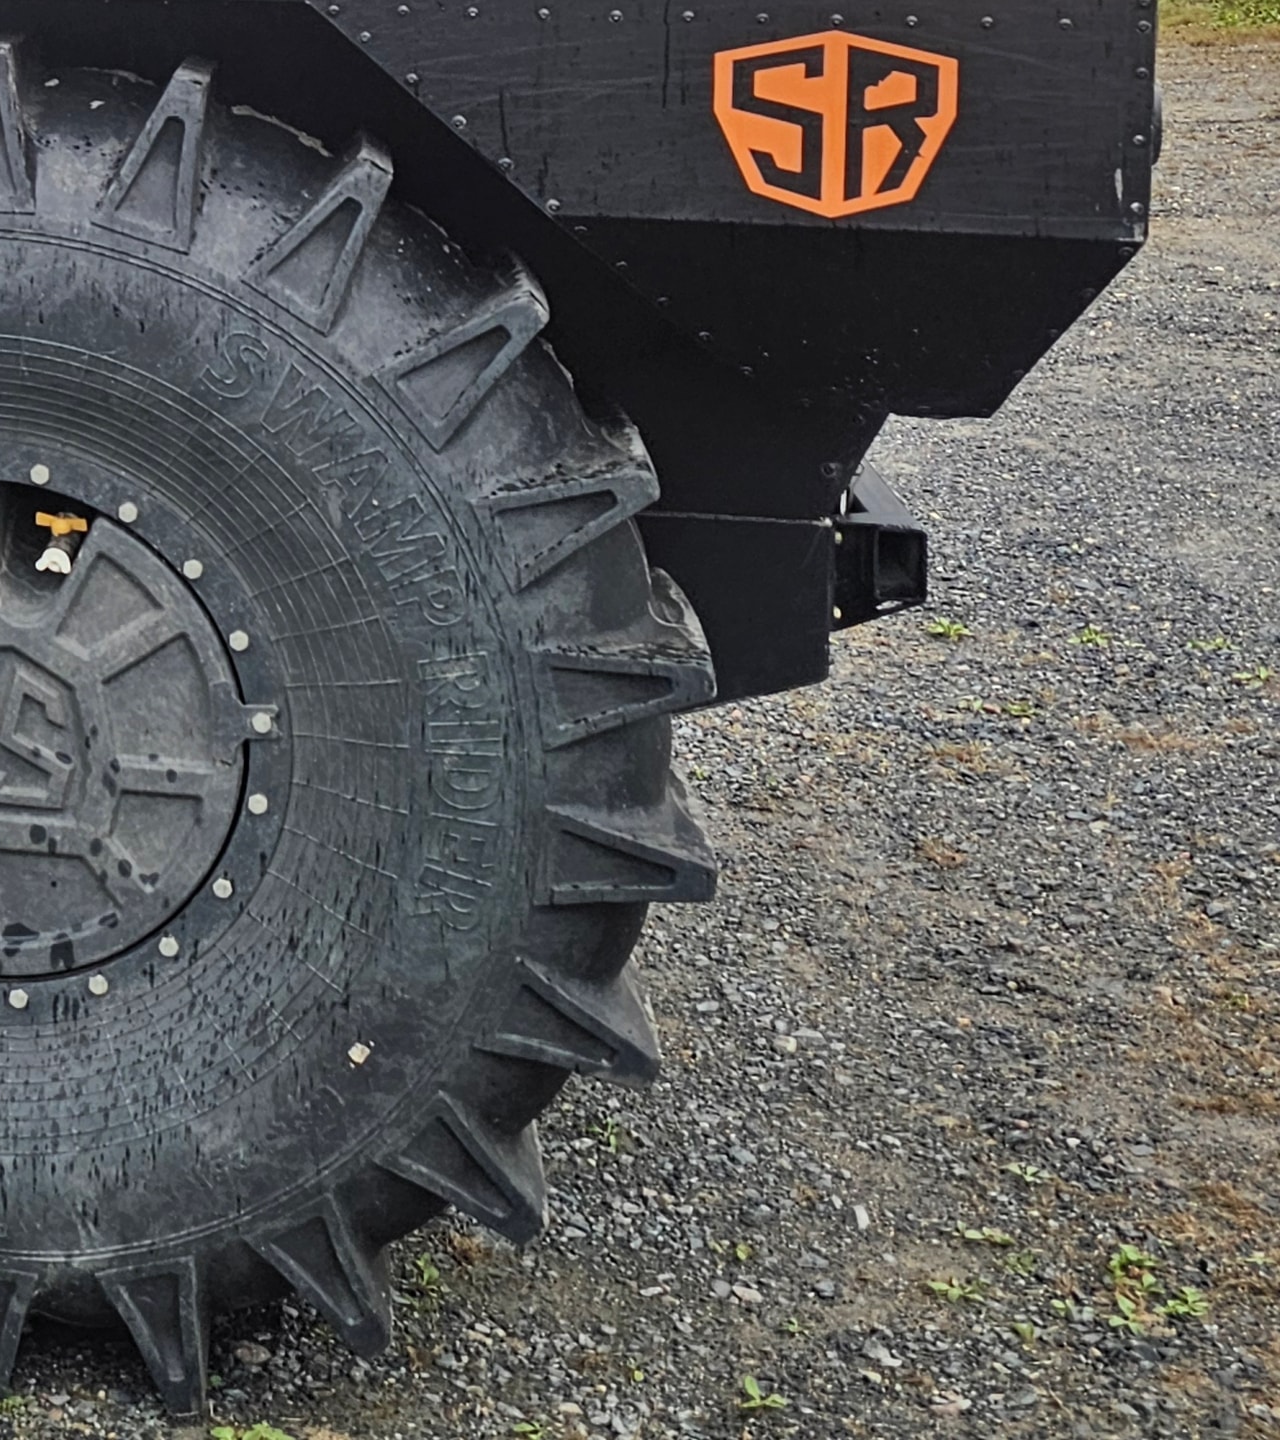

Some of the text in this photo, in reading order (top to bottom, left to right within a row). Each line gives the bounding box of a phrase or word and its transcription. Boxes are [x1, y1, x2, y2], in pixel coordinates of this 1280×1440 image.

[730, 43, 940, 202] SR
[199, 331, 502, 933] SWAMP RIDER
